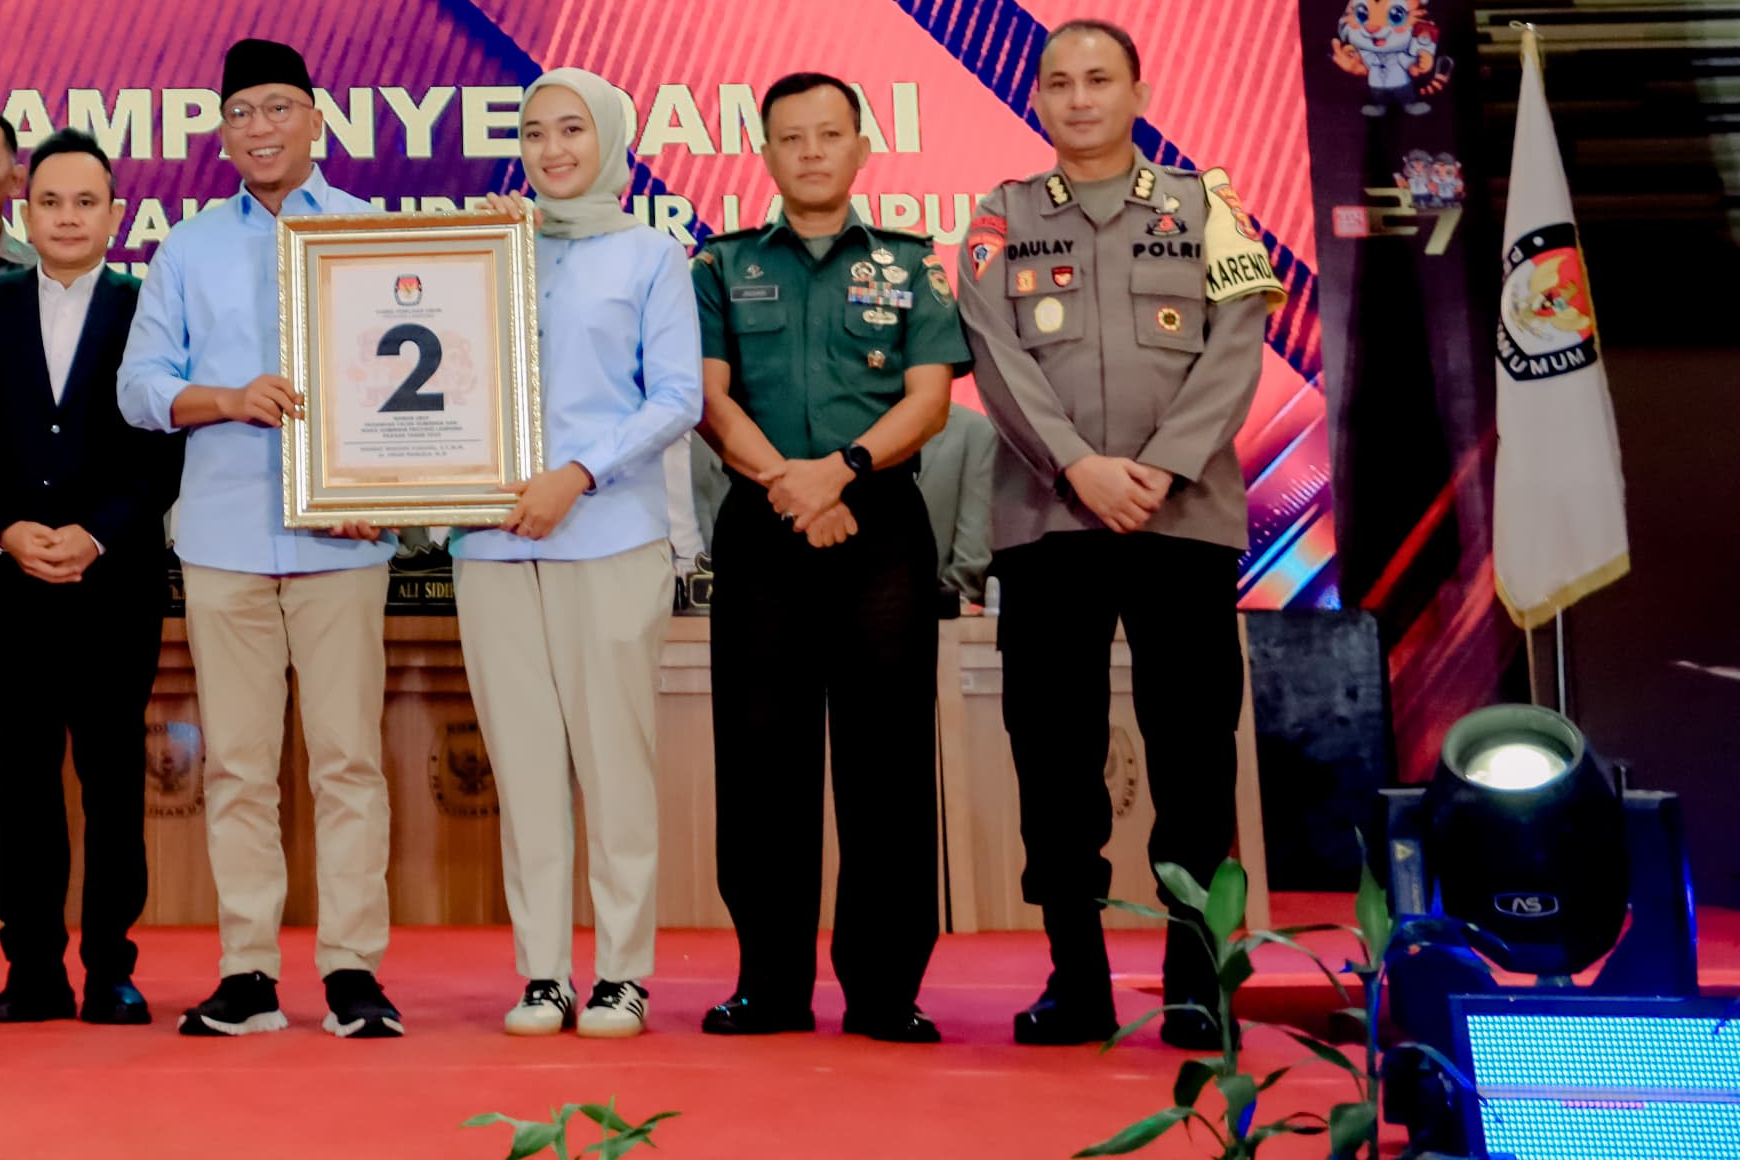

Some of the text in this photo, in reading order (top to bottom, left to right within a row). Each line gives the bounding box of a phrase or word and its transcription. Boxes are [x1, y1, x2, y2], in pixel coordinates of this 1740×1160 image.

[1008, 241, 1074, 261] DAULAY
[1132, 242, 1202, 259] POLRI
[375, 322, 445, 413] 2
[1509, 347, 1587, 376] UMUM
